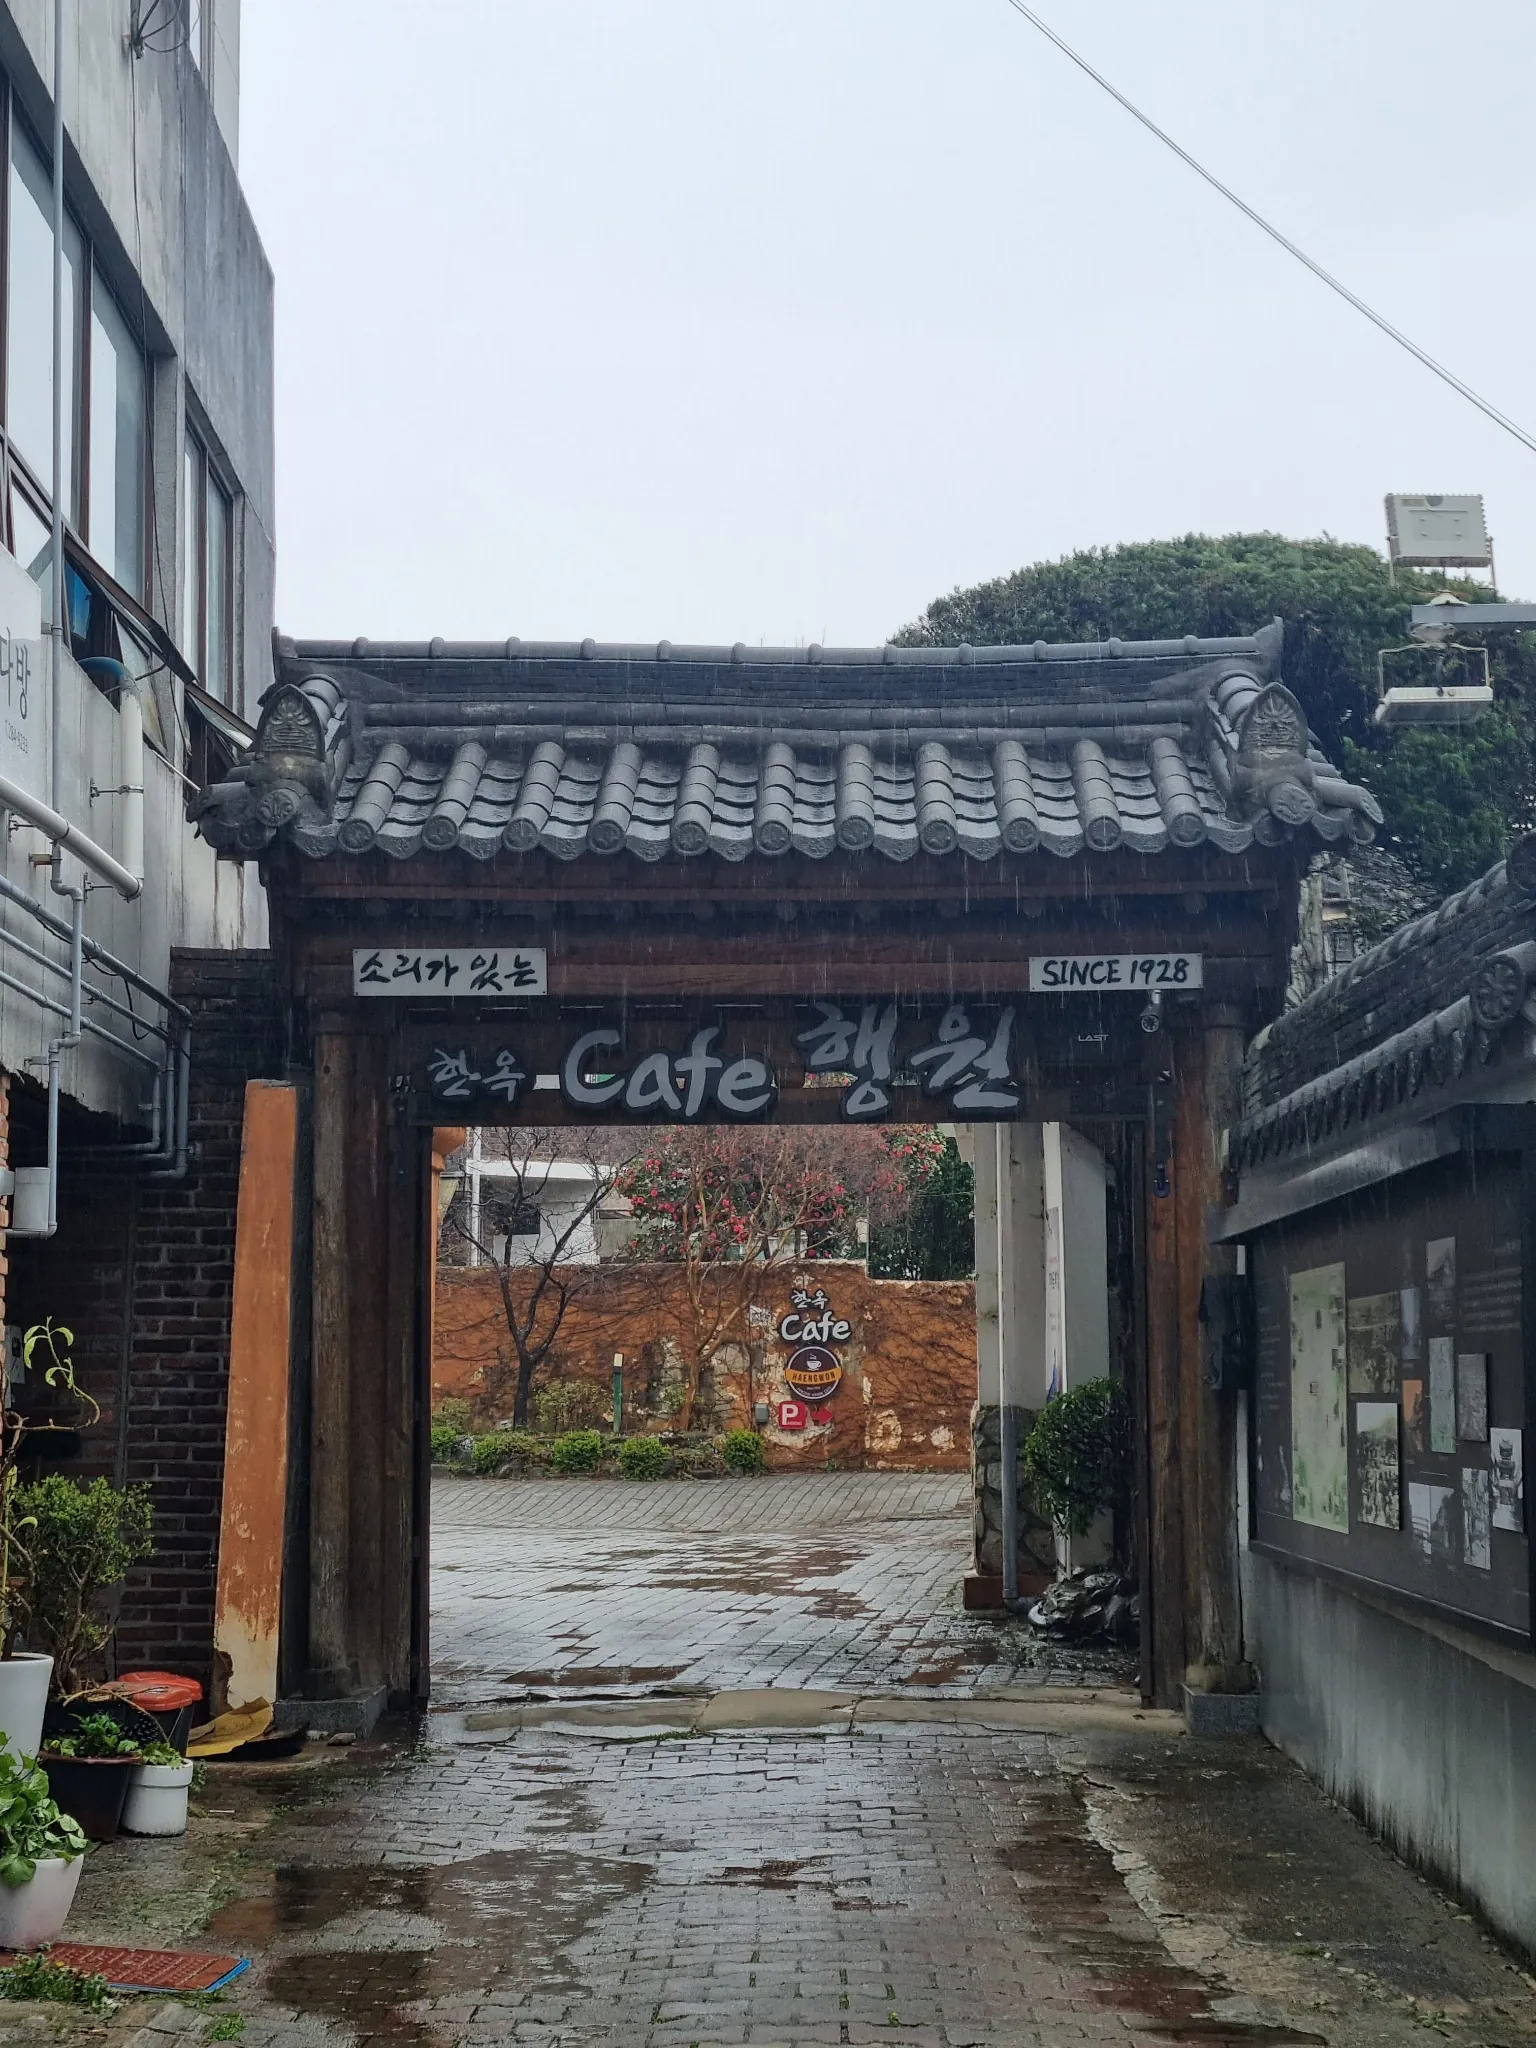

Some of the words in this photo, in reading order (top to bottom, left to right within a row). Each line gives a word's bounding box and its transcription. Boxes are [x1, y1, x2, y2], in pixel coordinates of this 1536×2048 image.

[359, 952, 459, 987] 소리가
[470, 953, 538, 991] 있는
[1041, 958, 1121, 986] SINCE
[1129, 957, 1189, 984] 1928
[427, 1048, 526, 1102] 한옥
[565, 1027, 772, 1117] Cafe
[797, 1002, 1020, 1115] 행원
[791, 1290, 828, 1309] 한옥
[781, 1311, 852, 1343] Cafe
[792, 1371, 836, 1383] HAENGWON
